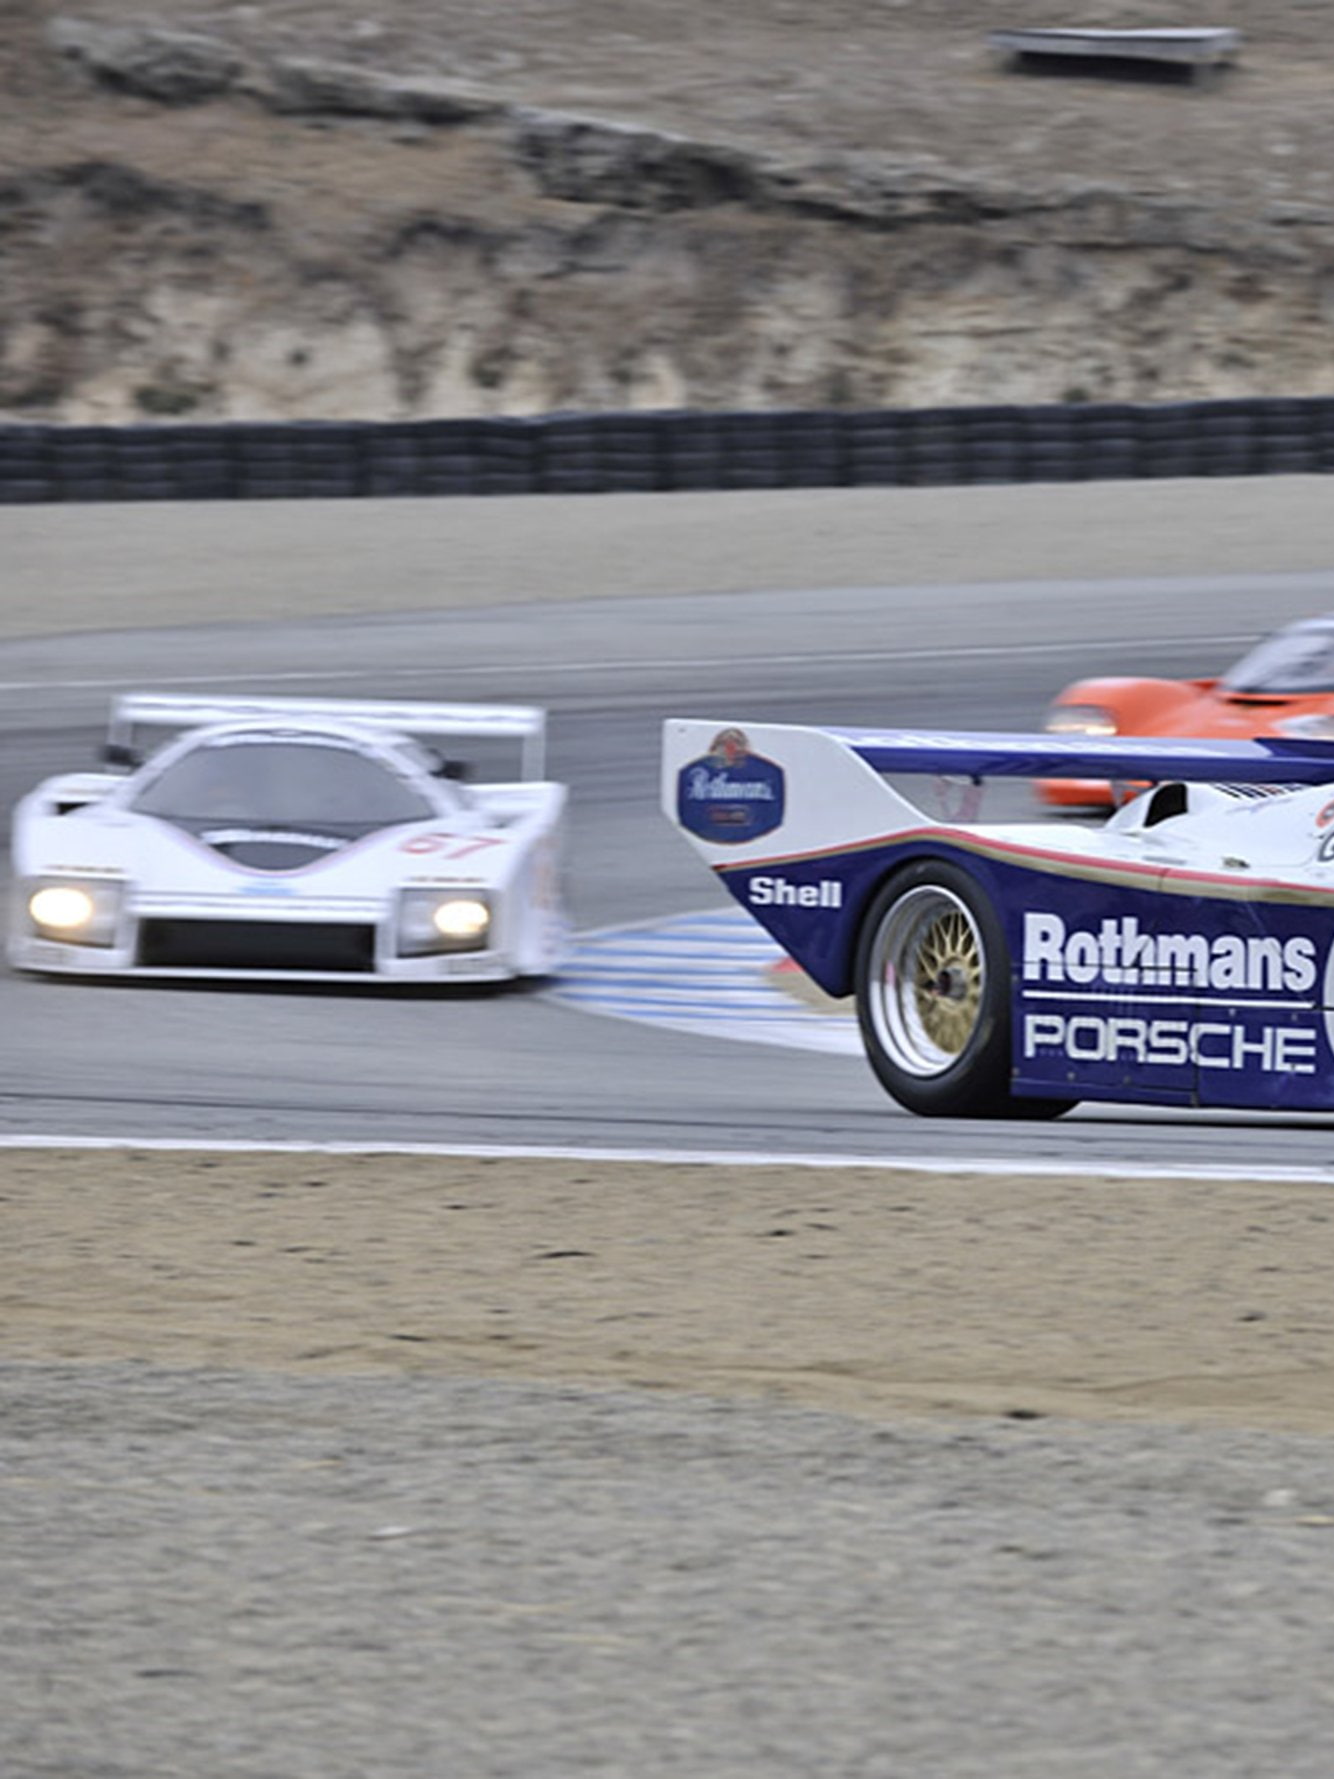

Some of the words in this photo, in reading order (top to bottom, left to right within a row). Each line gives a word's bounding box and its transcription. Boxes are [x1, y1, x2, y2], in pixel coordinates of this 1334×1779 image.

[750, 877, 842, 908] Shell
[1022, 911, 1317, 992] Rothmans
[1023, 1013, 1317, 1074] PORSCHE
